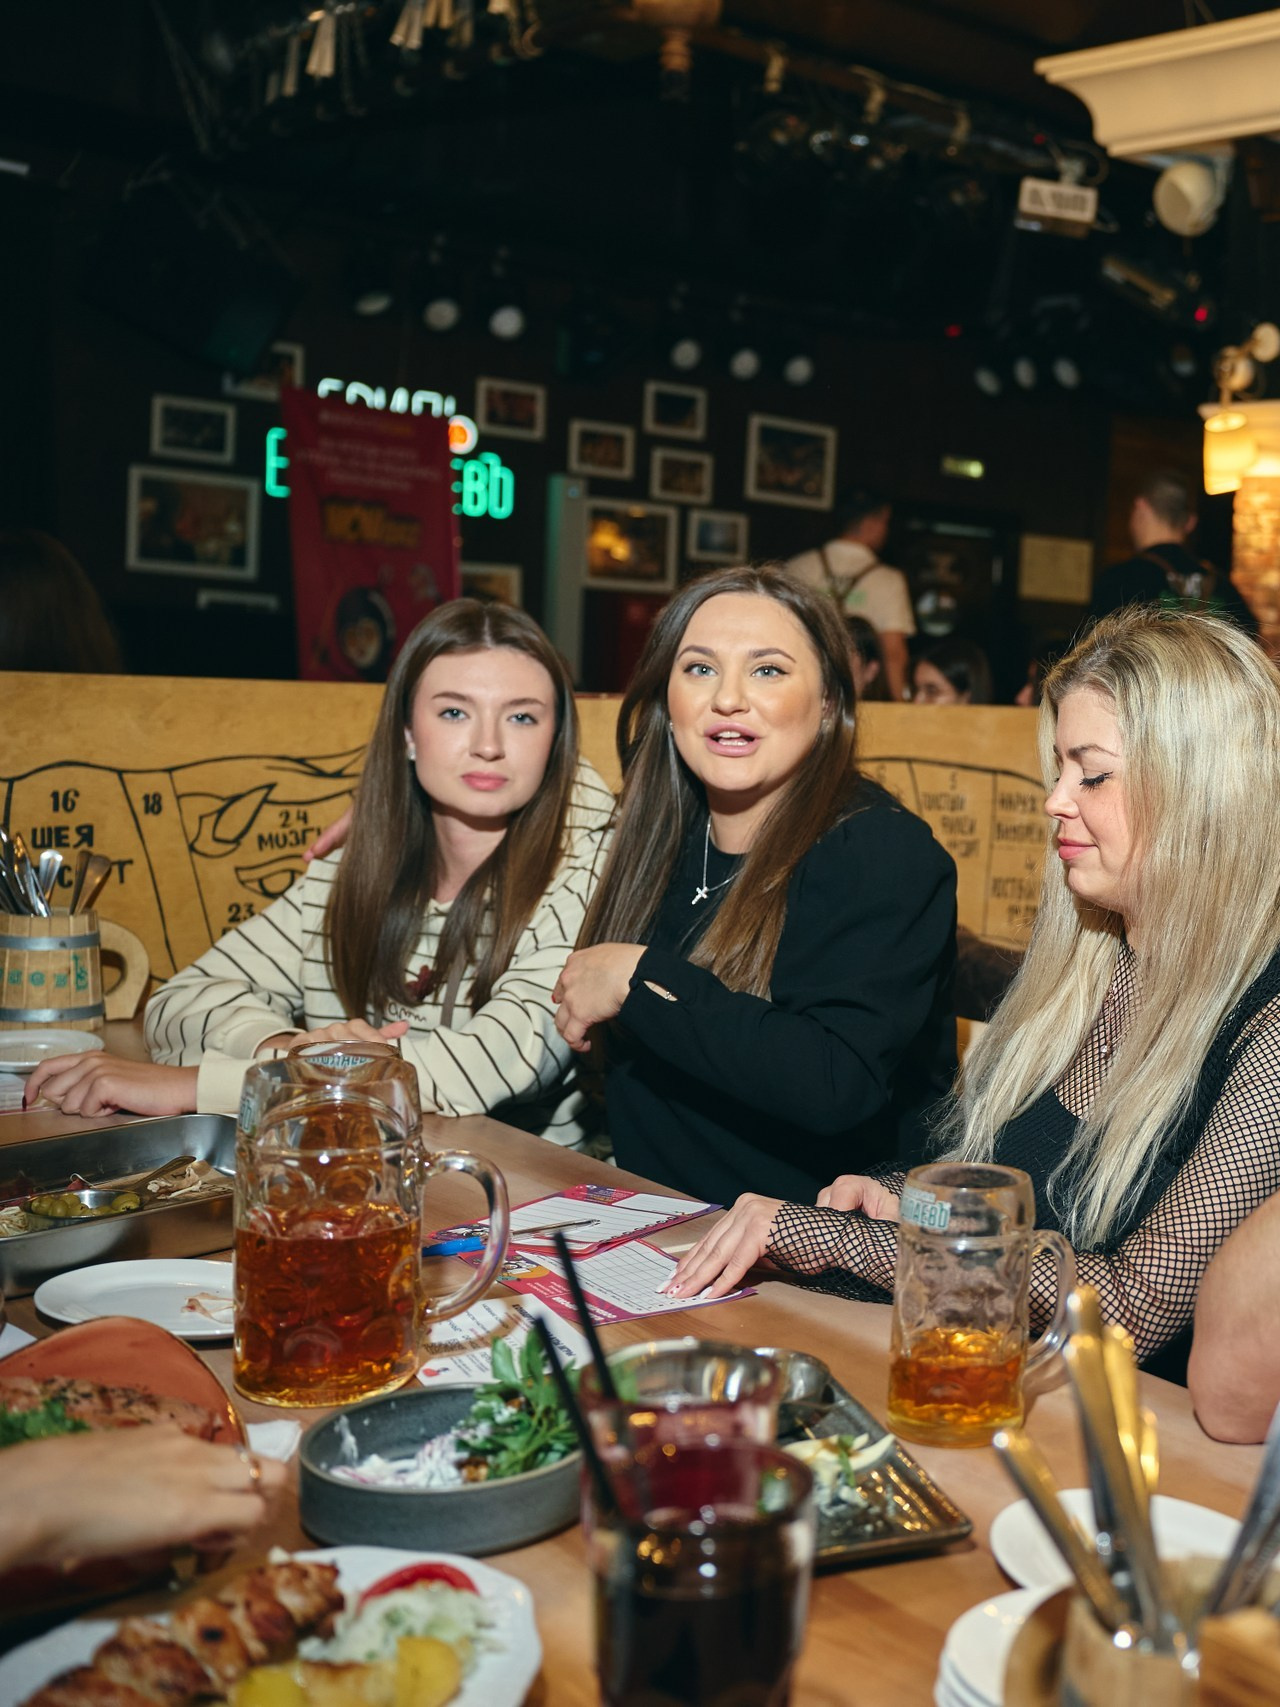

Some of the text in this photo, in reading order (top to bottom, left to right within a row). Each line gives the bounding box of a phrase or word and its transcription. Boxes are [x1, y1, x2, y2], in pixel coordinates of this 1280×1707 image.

[50, 788, 80, 813] 16
[142, 793, 162, 816] 18
[279, 808, 309, 828] 24
[31, 824, 94, 849] ШЕЯ
[228, 902, 256, 922] 23
